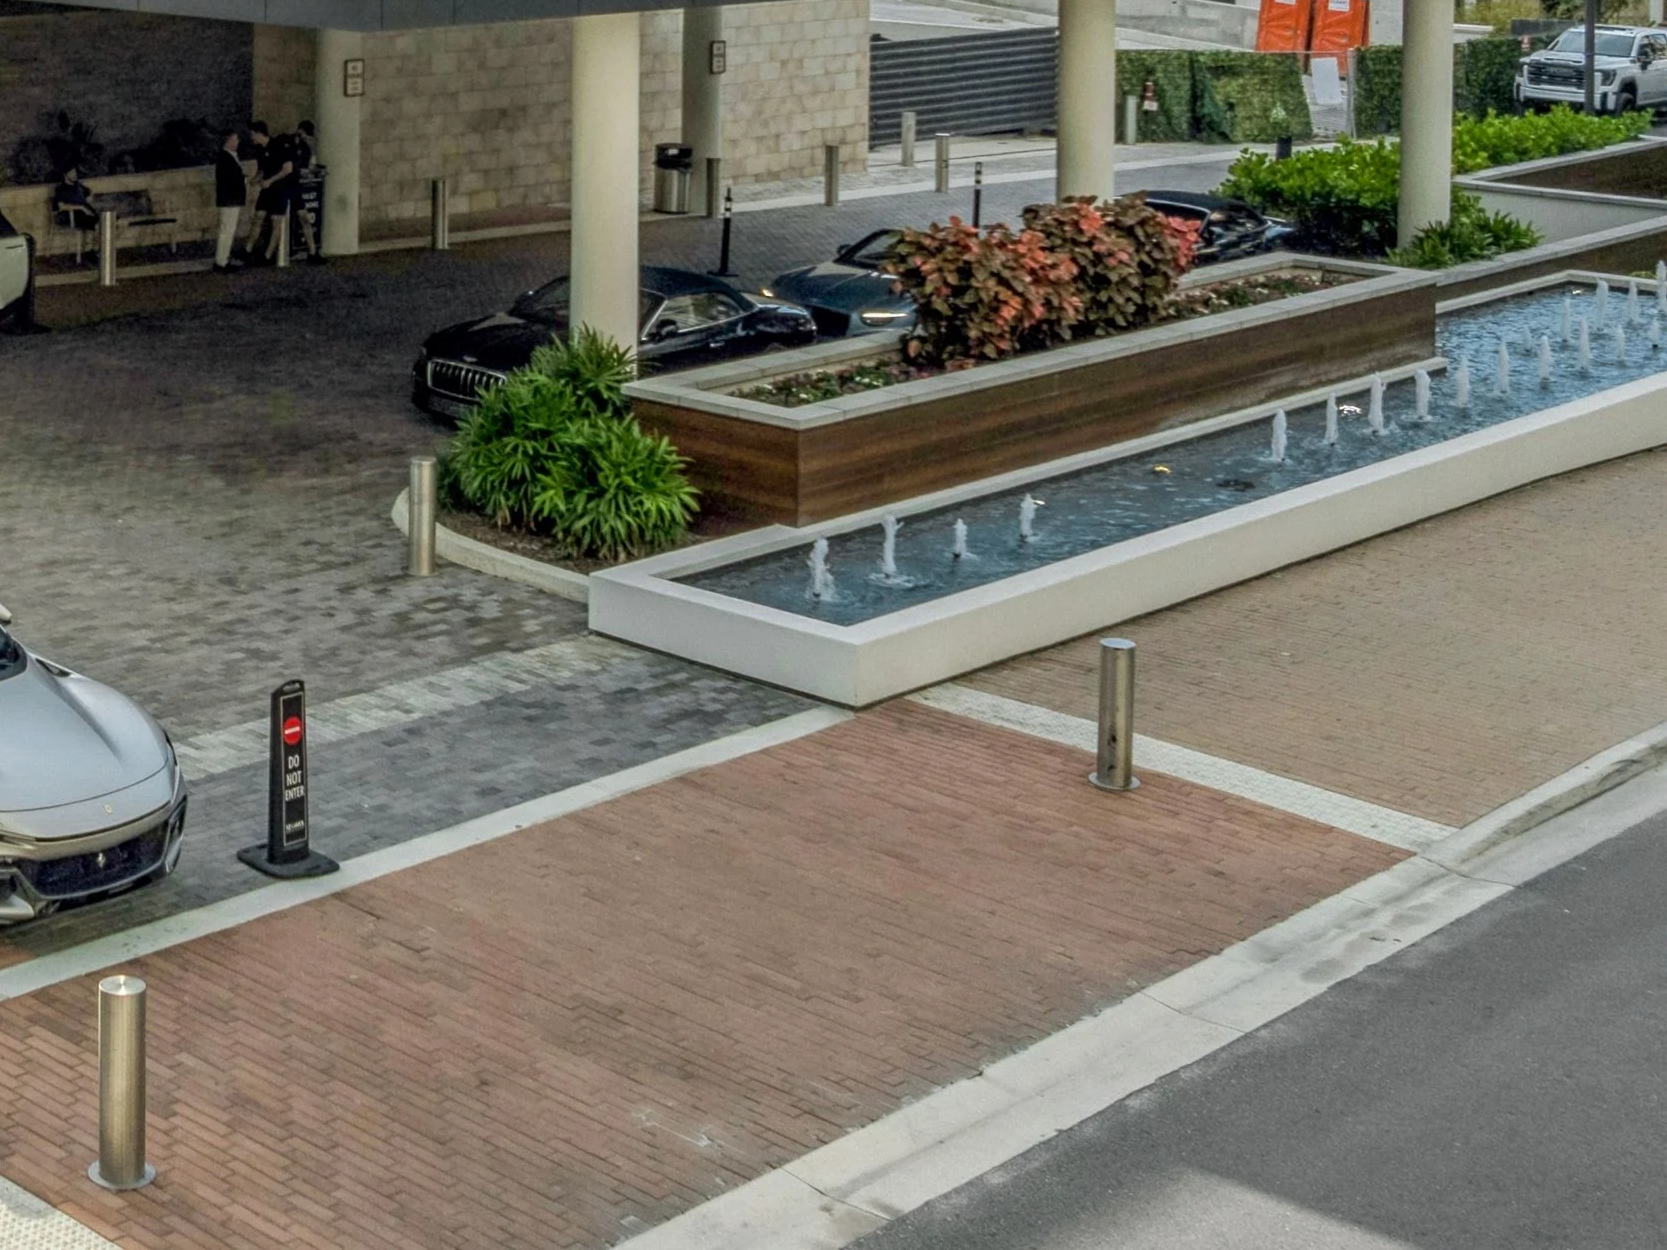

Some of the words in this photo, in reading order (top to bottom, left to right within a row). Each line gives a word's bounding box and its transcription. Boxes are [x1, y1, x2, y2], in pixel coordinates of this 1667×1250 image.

[288, 754, 300, 770] DO
[286, 770, 303, 787] NOT
[285, 786, 305, 802] ENTER
